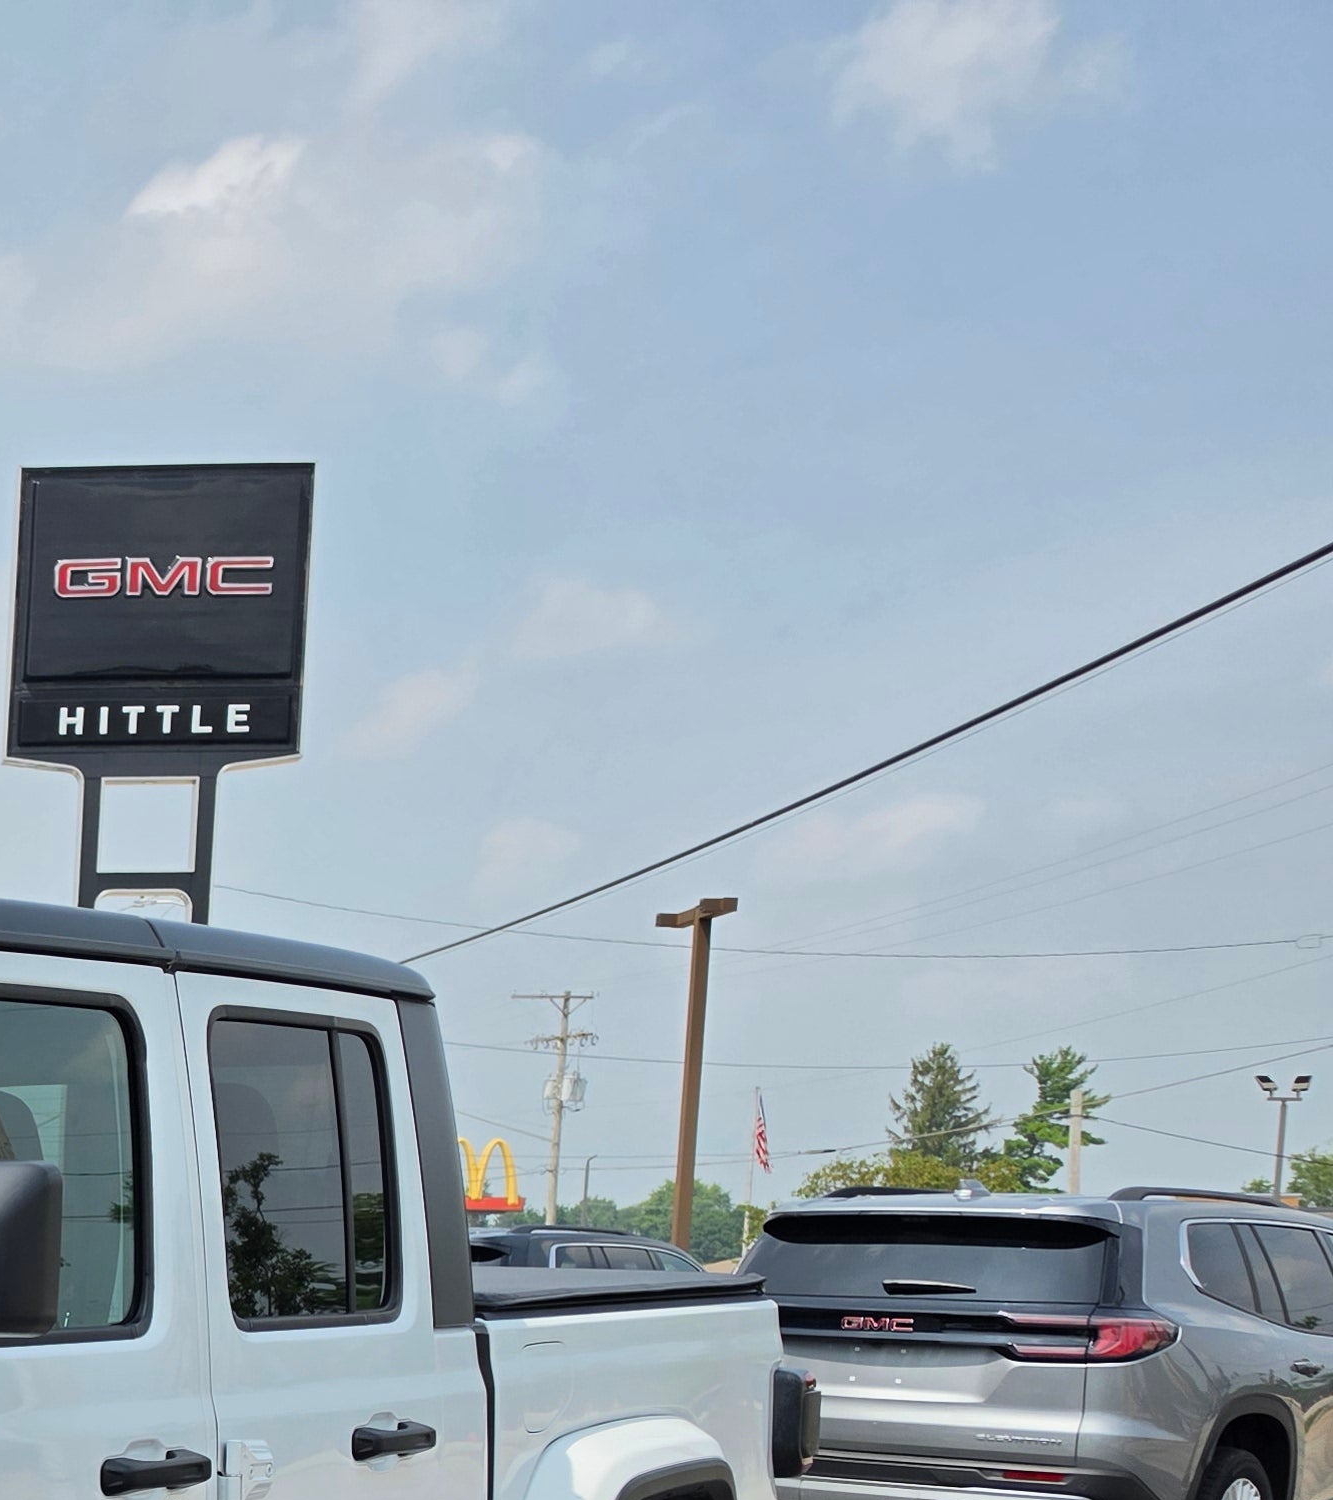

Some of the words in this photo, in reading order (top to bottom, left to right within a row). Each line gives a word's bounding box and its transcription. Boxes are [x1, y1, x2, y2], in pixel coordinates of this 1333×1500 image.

[54, 555, 274, 598] GMC
[58, 704, 250, 735] HITTLE
[841, 1316, 914, 1332] GMC
